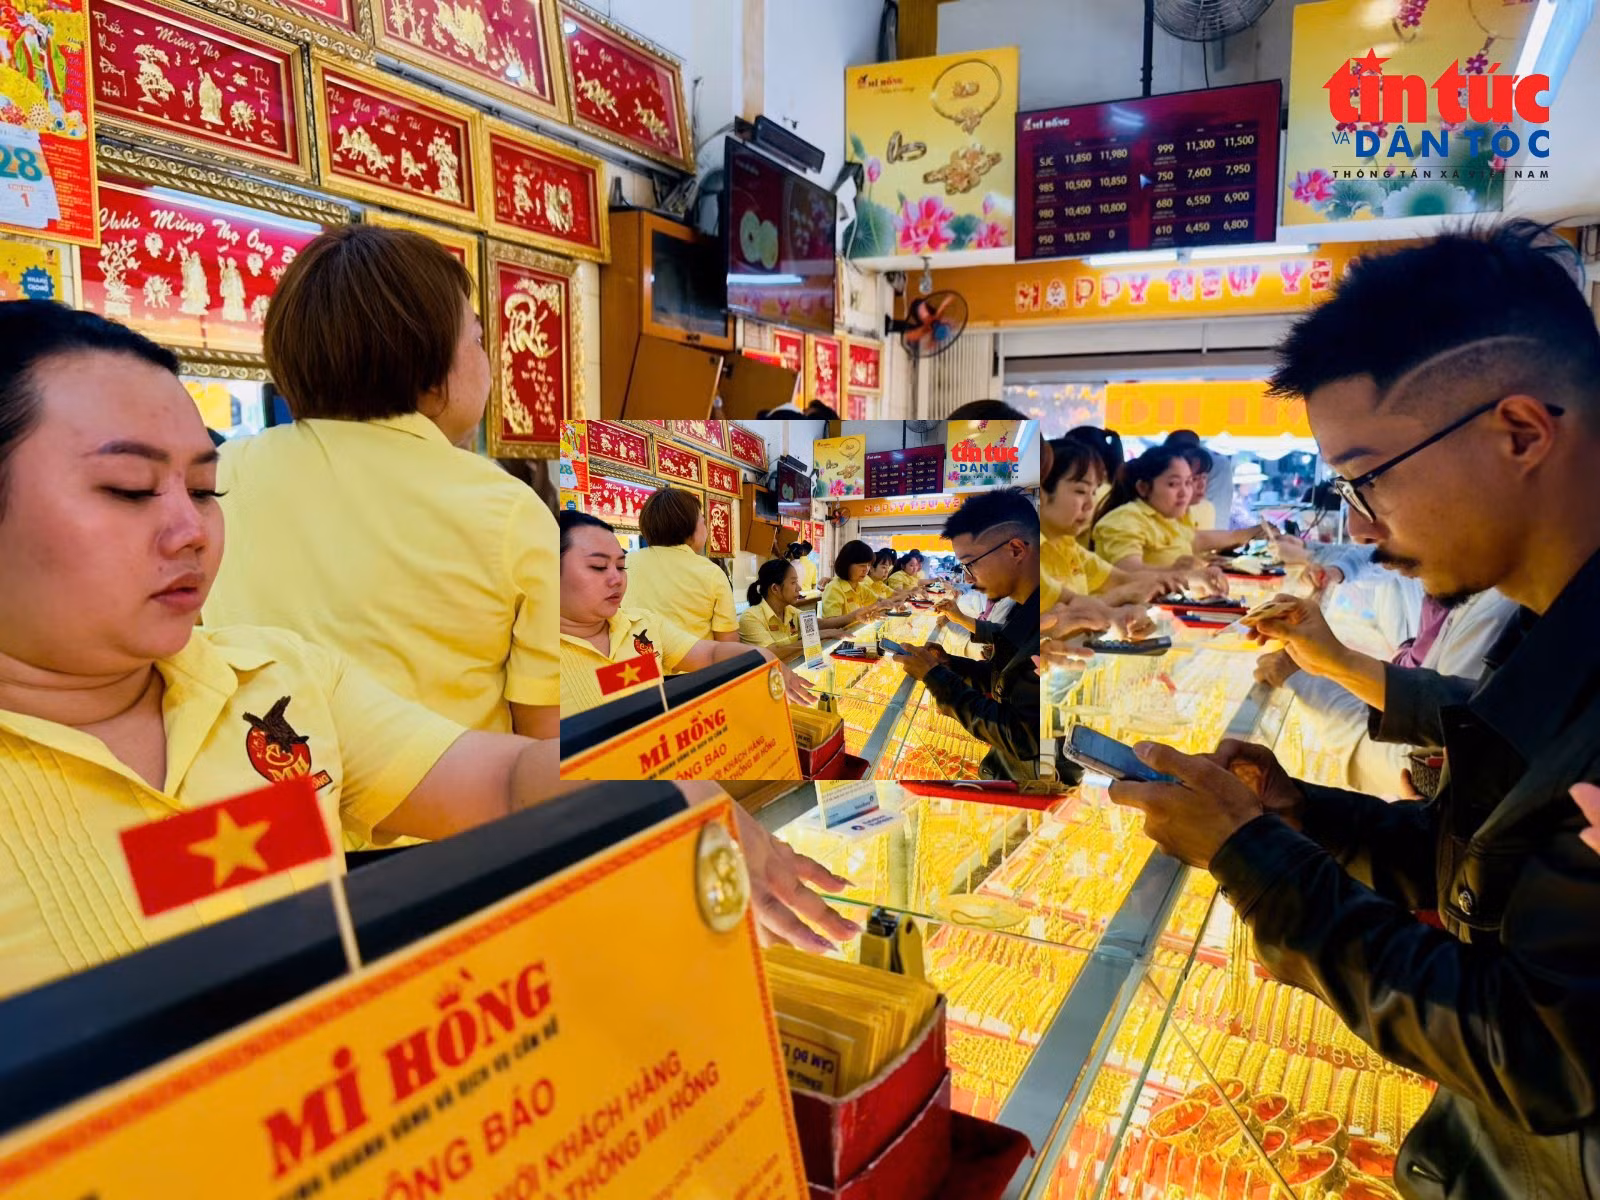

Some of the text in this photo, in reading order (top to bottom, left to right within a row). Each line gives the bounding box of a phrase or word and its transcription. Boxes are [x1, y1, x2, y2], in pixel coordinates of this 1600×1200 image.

[1157, 135, 1254, 154] 999 11,300 11,500
[0, 145, 43, 182] 28
[1039, 156, 1054, 167] SJC
[1157, 163, 1251, 181] 750 7,600 7,950
[1064, 180, 1091, 191] 10,500
[1156, 198, 1173, 208] 680
[1224, 191, 1250, 204] 6,900
[99, 208, 141, 231] Chúc
[150, 209, 205, 239] Mừng
[281, 245, 299, 264] B
[1155, 219, 1248, 235] 610 6,450 6,800
[1016, 257, 1340, 312] HAPPY NEW YE
[385, 962, 551, 1104] HỒNG
[482, 1077, 556, 1156] BÁO
[544, 1097, 624, 1179] KHÁCH
[626, 1049, 682, 1112] HÀNG
